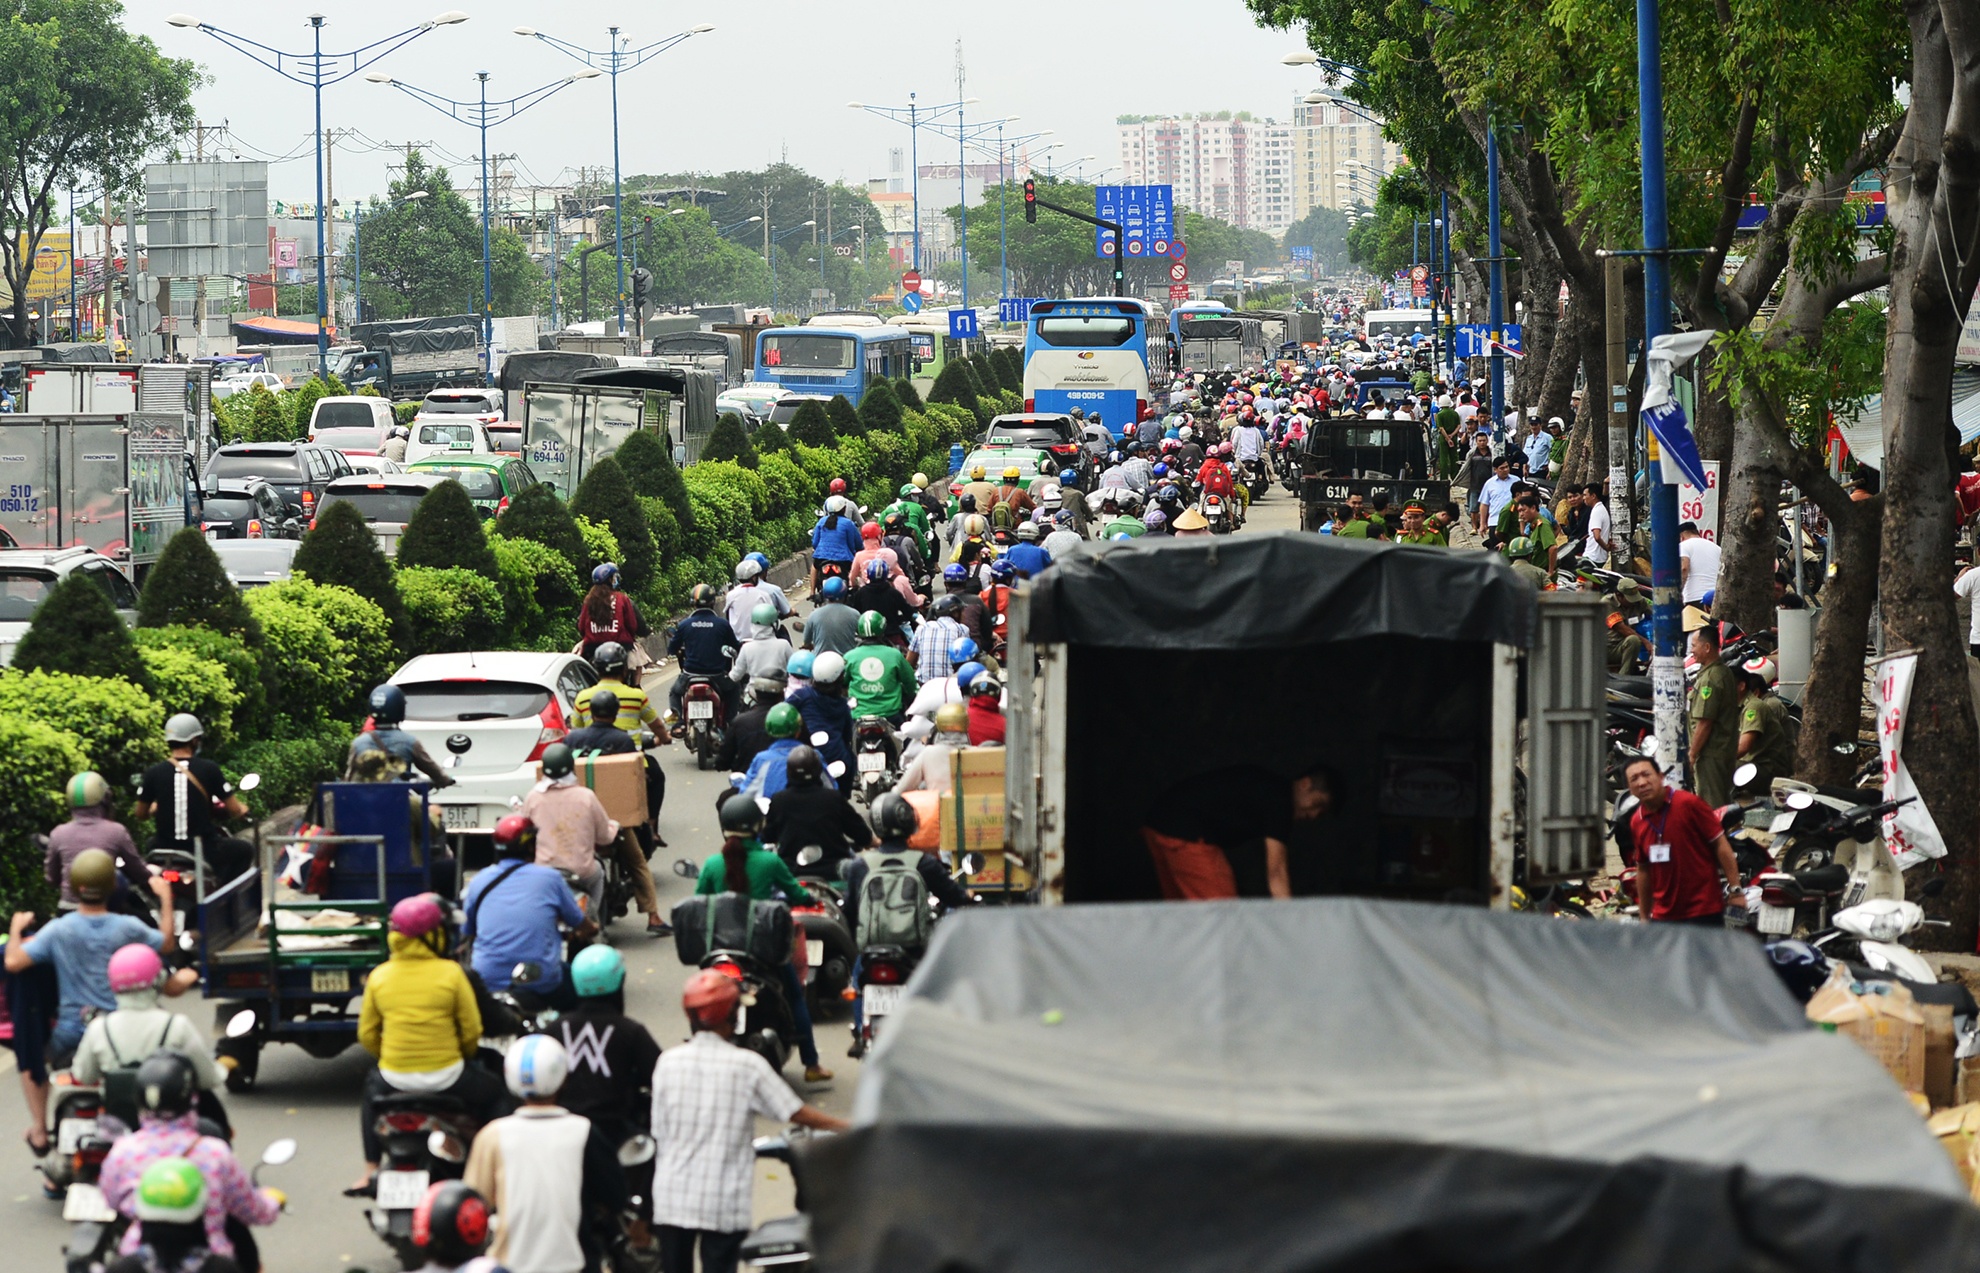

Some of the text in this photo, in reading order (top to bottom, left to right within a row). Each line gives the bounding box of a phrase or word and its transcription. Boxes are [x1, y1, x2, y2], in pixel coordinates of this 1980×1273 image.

[765, 349, 781, 366] 104
[541, 440, 559, 451] 51C
[533, 451, 565, 463] 694.40
[10, 484, 31, 498] 51D
[1326, 485, 1349, 498] 61N
[1412, 487, 1428, 500] 47
[0, 498, 38, 512] 050.12
[691, 620, 714, 628] adidas
[861, 682, 885, 693] Grab
[447, 807, 469, 821] 51F
